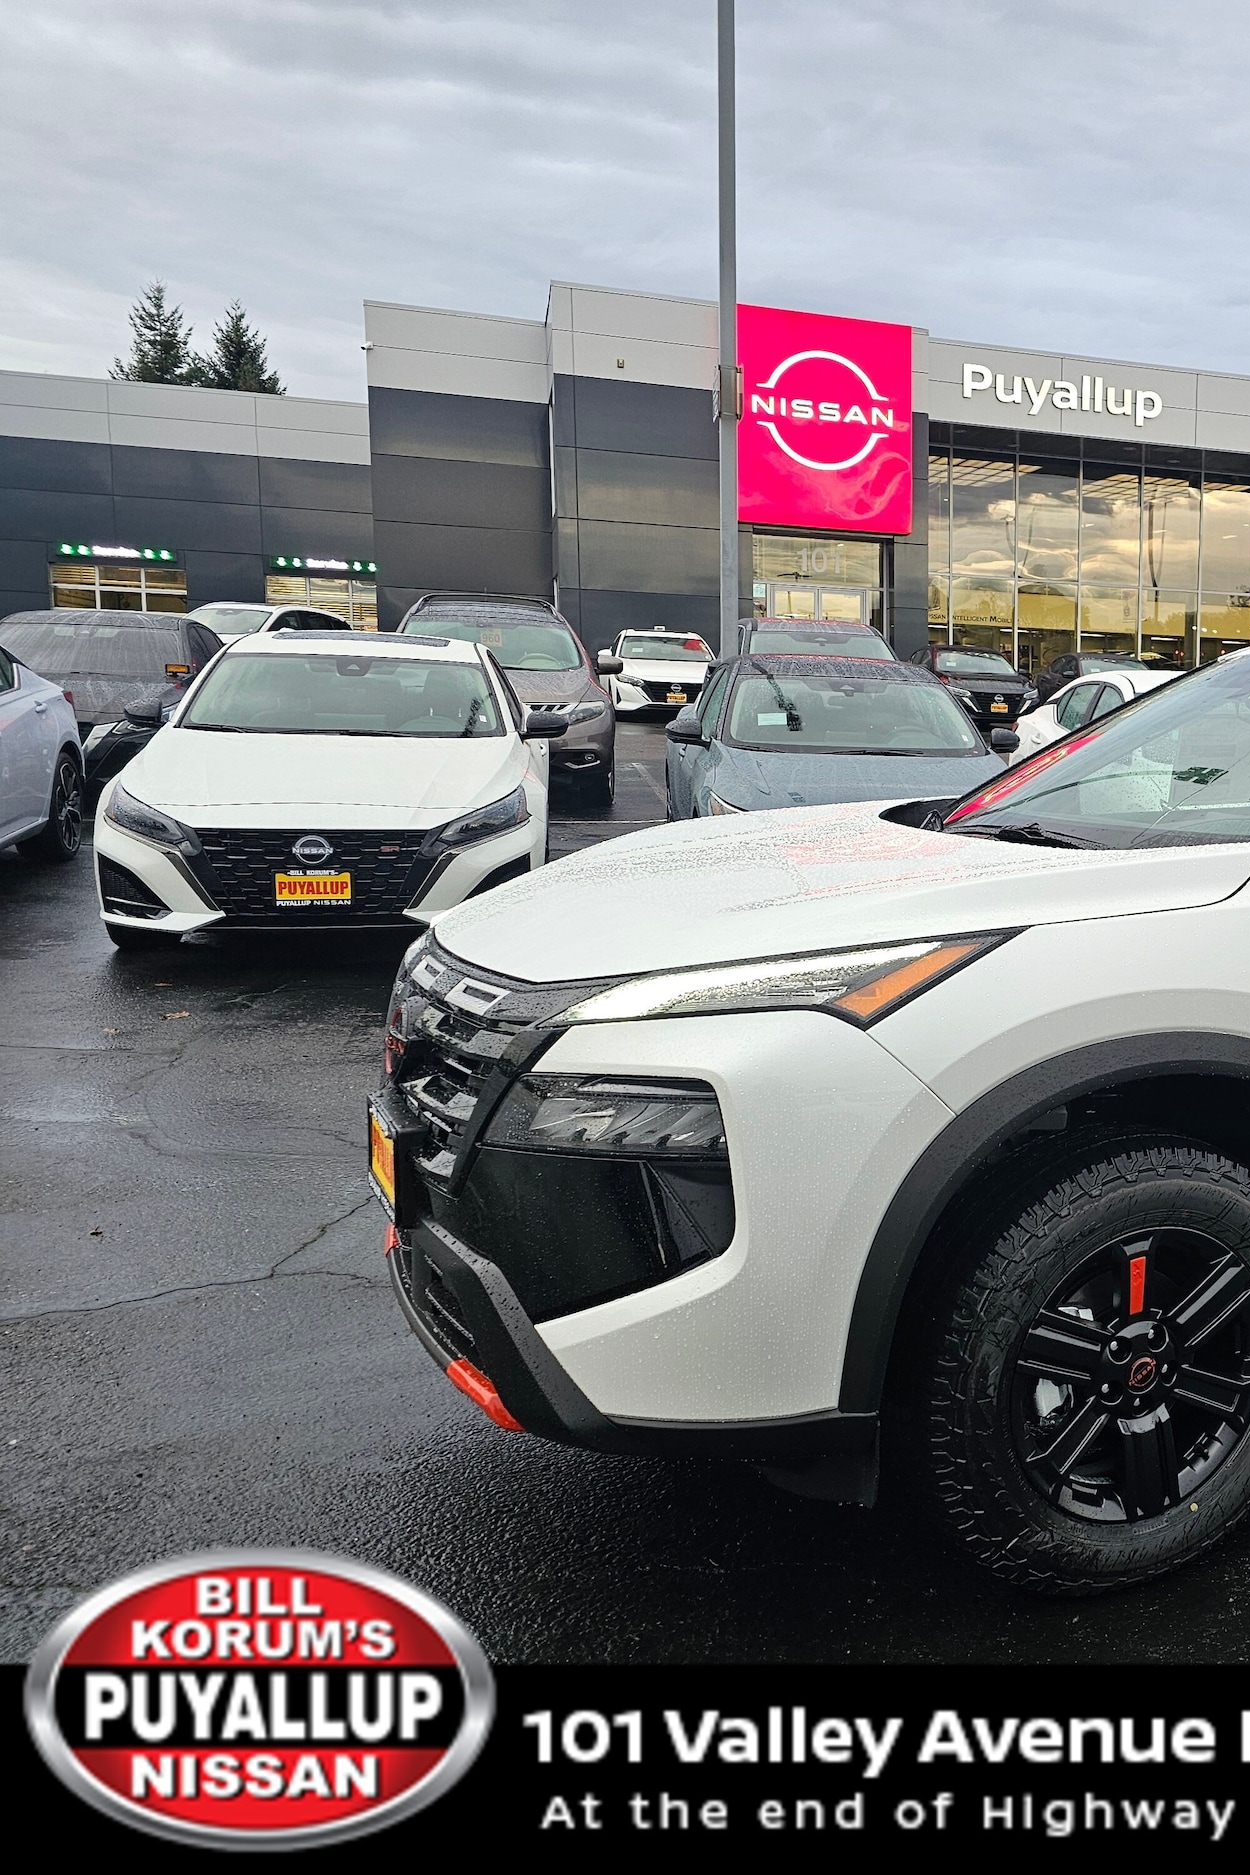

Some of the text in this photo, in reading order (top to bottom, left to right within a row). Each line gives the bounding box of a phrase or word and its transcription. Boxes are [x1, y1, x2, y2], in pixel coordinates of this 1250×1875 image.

[962, 363, 1163, 427] Puyallup
[751, 394, 894, 427] NISSAN
[797, 547, 841, 574] 101
[292, 846, 333, 854] NISSAN
[277, 881, 349, 895] PUYALLUP
